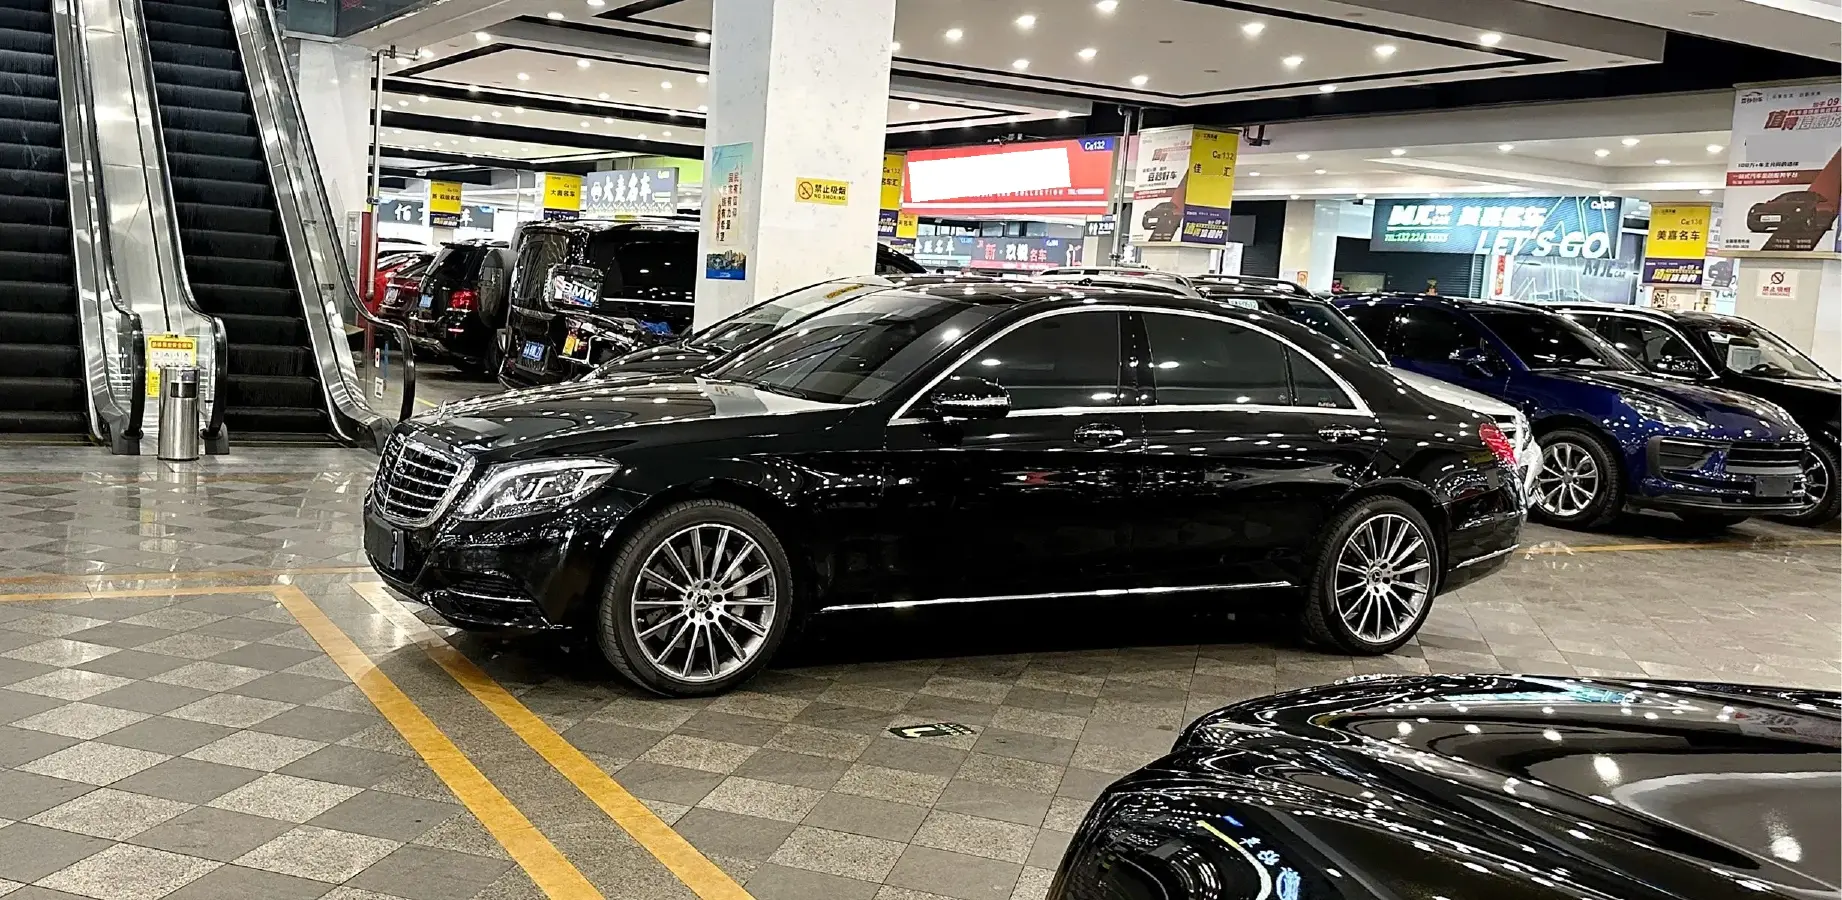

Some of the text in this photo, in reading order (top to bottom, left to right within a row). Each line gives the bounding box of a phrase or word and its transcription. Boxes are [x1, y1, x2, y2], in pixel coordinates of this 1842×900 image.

[1827, 97, 1840, 107] 09
[814, 184, 846, 195] 禁止吸烟
[1656, 230, 1701, 241] 美嘉名车
[1558, 230, 1608, 260] GO
[562, 280, 598, 301] BMW
